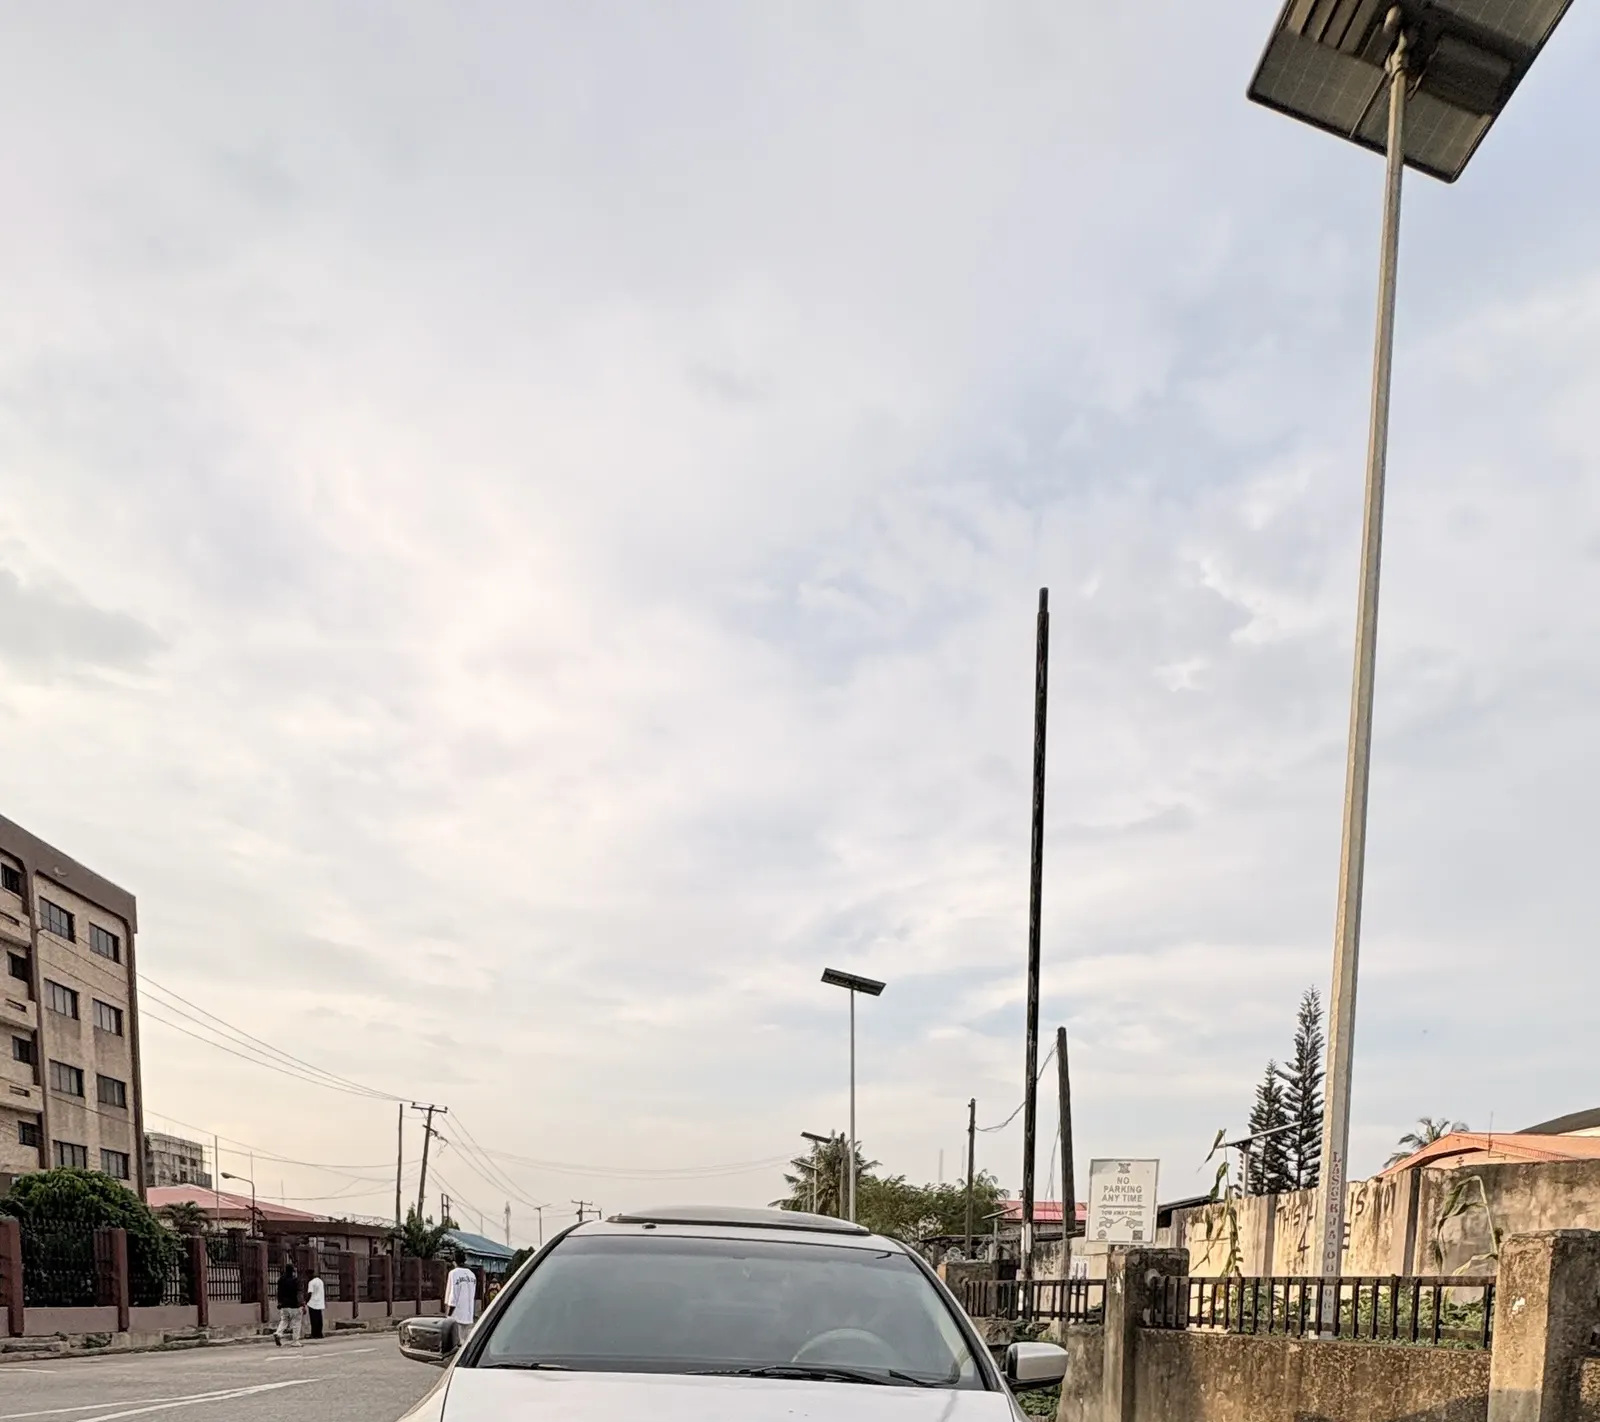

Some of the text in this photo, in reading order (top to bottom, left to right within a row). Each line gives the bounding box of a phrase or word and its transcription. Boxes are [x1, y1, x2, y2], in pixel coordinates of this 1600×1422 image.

[1103, 1185, 1142, 1193] PARKING
[1101, 1194, 1143, 1202] ANY TIME
